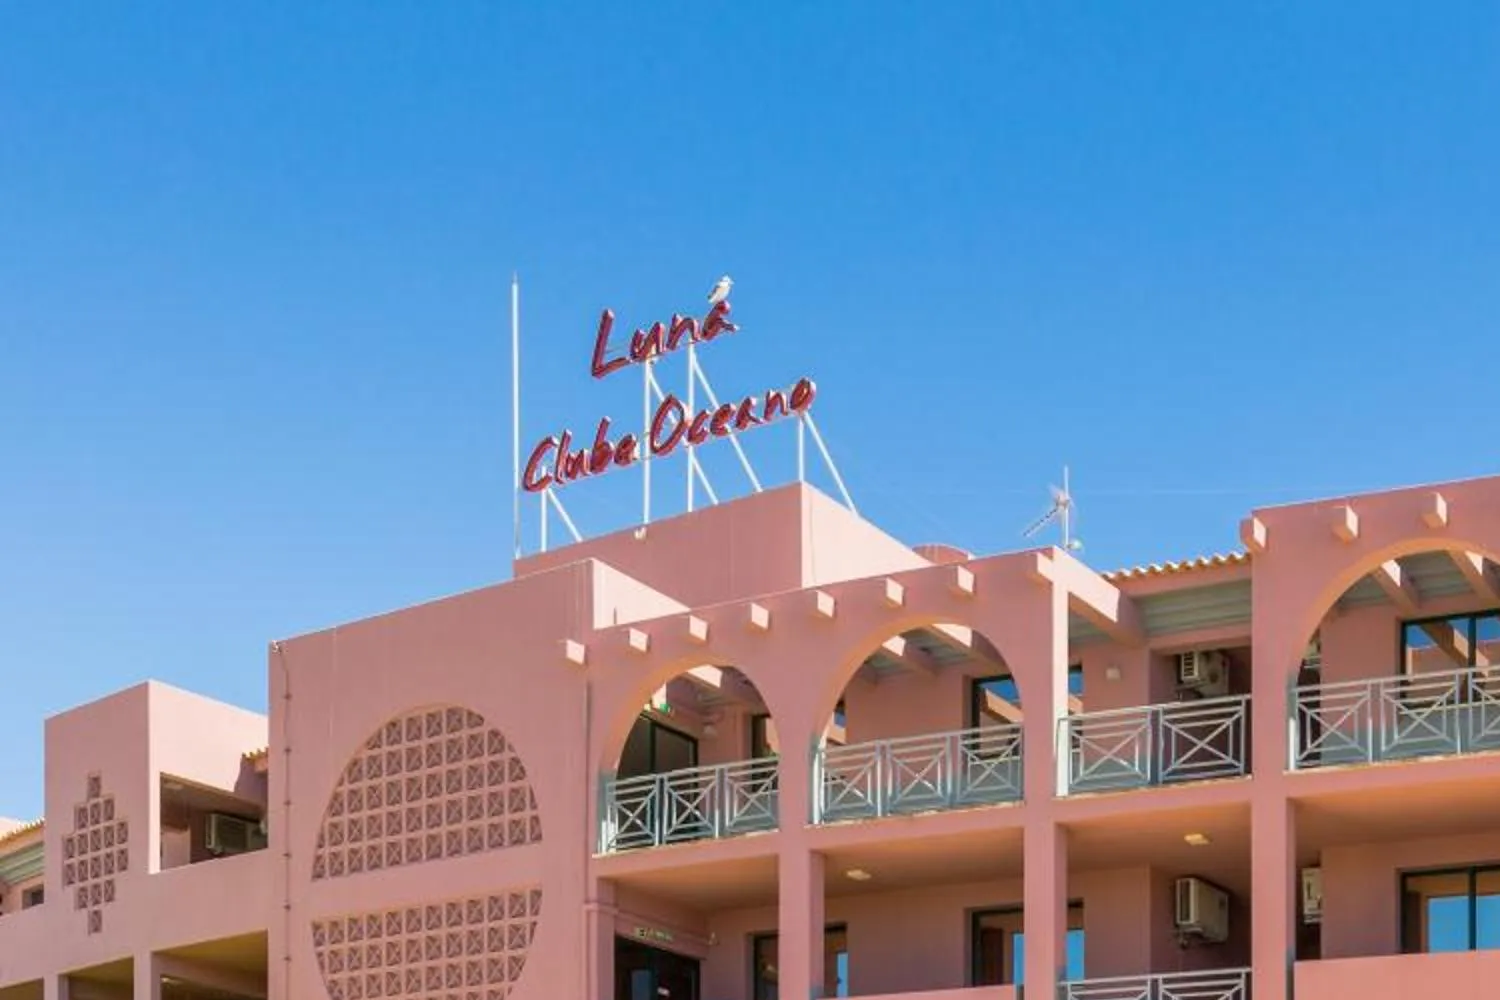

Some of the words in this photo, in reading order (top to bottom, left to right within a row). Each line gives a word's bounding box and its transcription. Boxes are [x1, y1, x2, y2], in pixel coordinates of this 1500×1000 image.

[591, 299, 740, 379] Luna
[522, 416, 639, 493] Clube
[648, 376, 817, 457] Oceano
